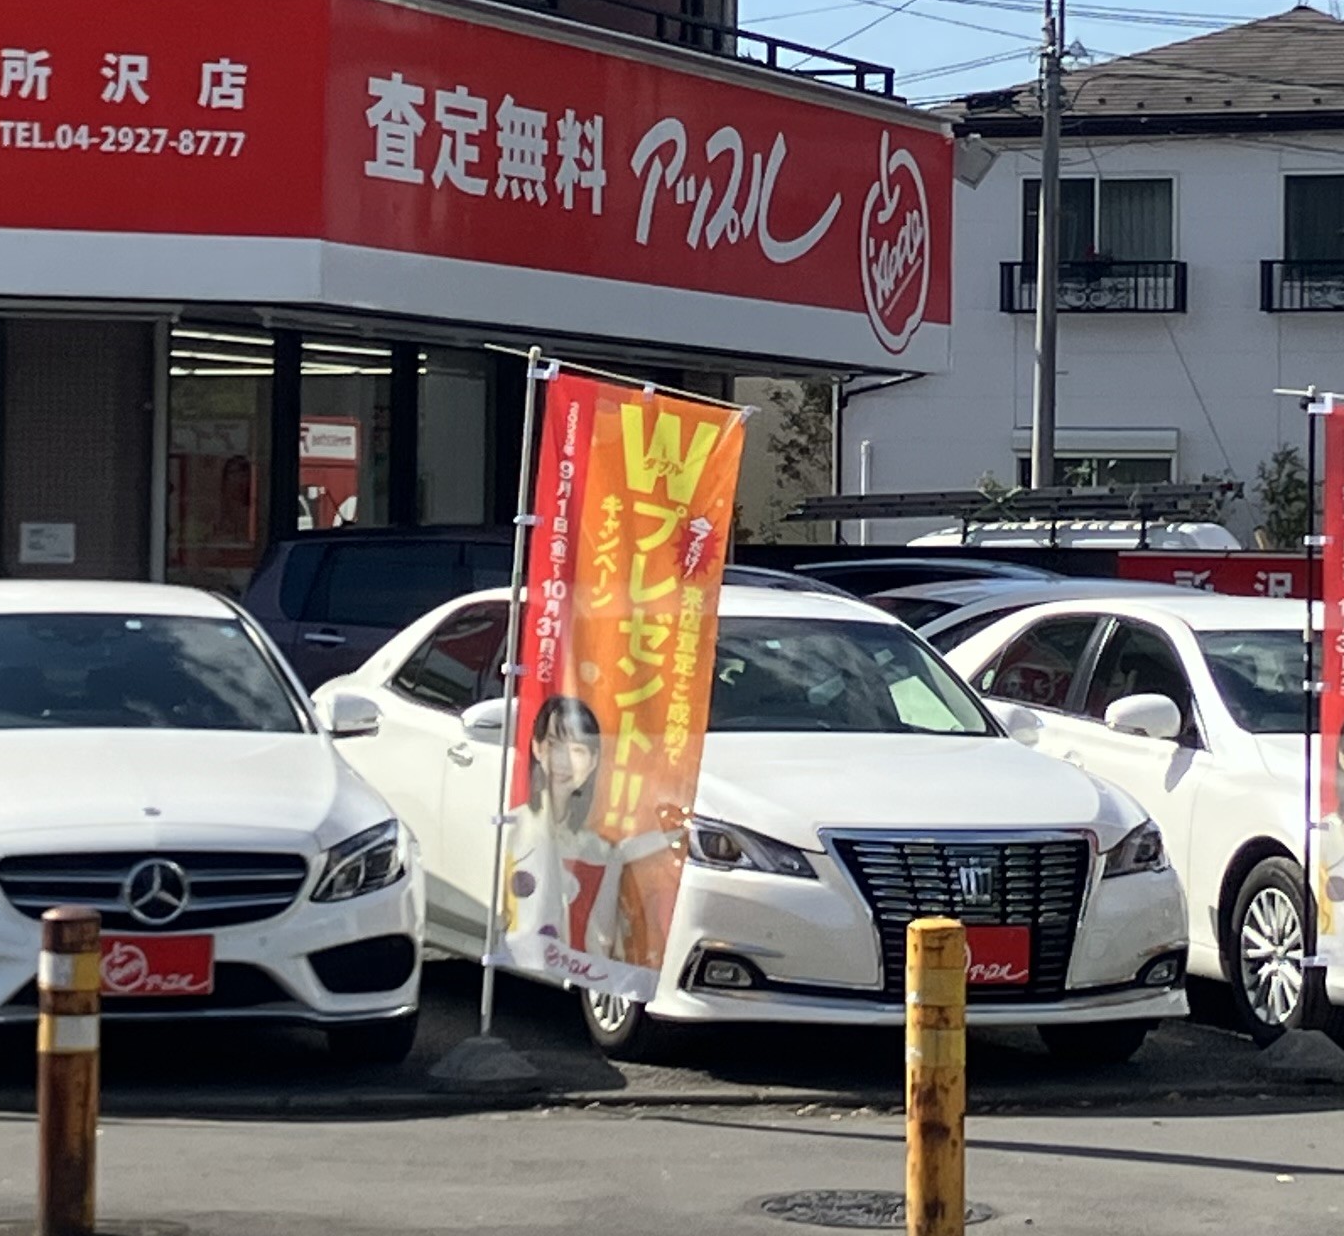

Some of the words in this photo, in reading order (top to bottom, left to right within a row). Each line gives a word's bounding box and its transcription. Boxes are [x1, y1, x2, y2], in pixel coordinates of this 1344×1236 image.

[364, 71, 607, 216] 査定無料
[630, 117, 843, 264] アップル
